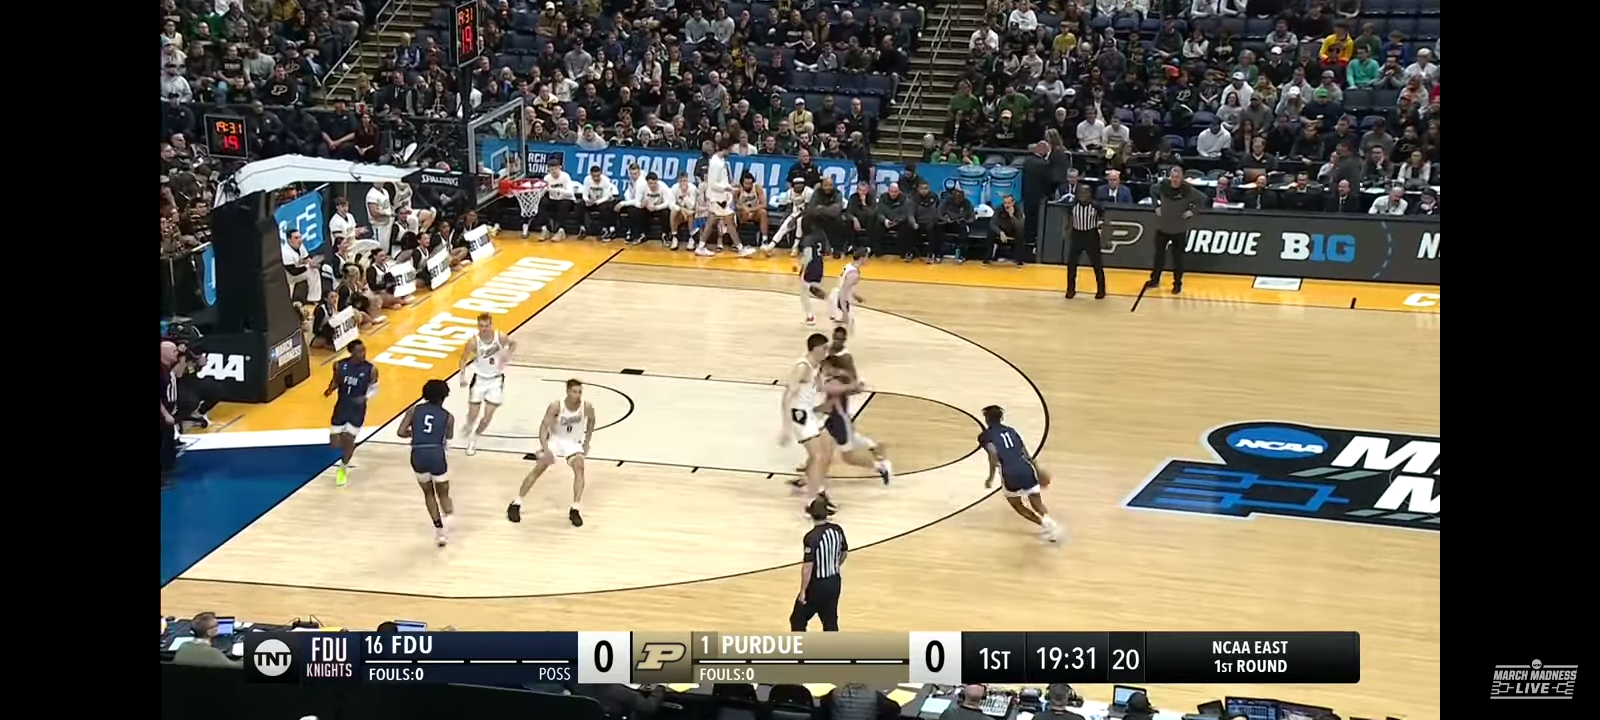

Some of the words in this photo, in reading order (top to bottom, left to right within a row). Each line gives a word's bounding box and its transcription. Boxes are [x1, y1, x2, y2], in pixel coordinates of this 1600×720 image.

[528, 152, 547, 163] RCH
[575, 152, 616, 177] THE
[421, 174, 459, 186] SPALDING
[1184, 229, 1262, 256] URDUE
[373, 312, 479, 370] FIRST
[452, 256, 575, 314] ROUND
[197, 352, 245, 382] AA
[423, 414, 434, 434] 5
[1000, 431, 1014, 449] 11
[1235, 438, 1324, 454] NCAA
